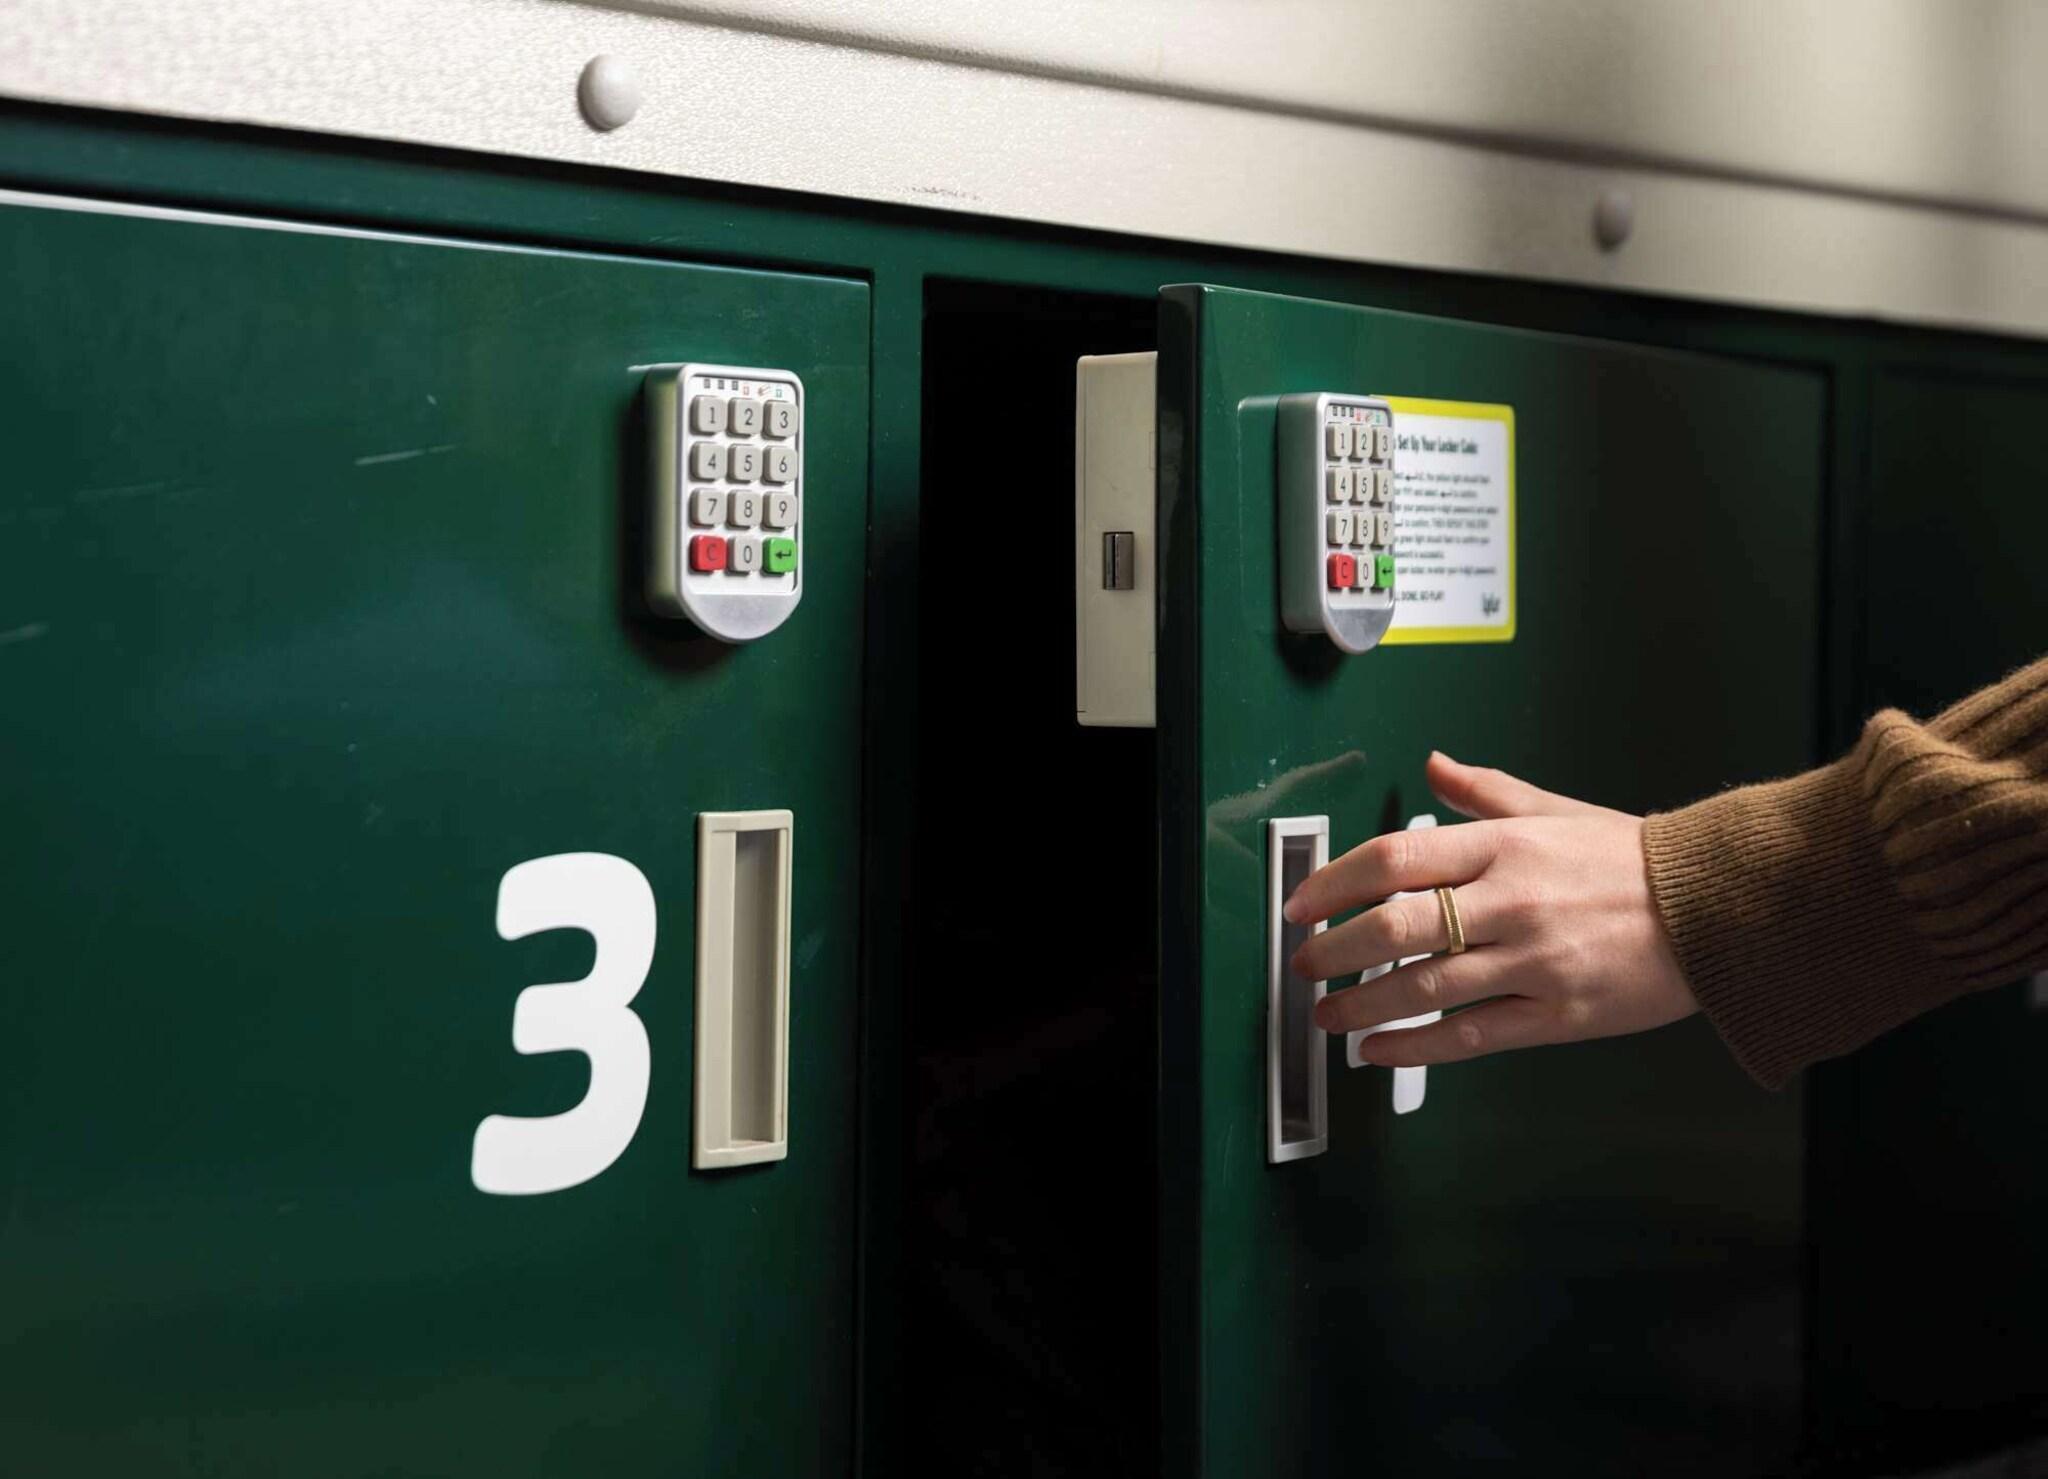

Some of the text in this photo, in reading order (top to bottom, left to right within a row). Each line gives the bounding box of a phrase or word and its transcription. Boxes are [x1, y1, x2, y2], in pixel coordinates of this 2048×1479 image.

[744, 408, 754, 426] 2
[779, 410, 789, 429] 3
[1361, 433, 1368, 450] 2
[1382, 435, 1389, 452] 3
[707, 452, 788, 473] 4 5 6
[1361, 477, 1368, 494] 5
[708, 498, 788, 518] 7 8 9
[1341, 519, 1348, 536] 7
[1362, 520, 1369, 537] 8
[707, 543, 753, 564] C 0
[1362, 563, 1369, 580] 0
[471, 852, 657, 1196] 3
